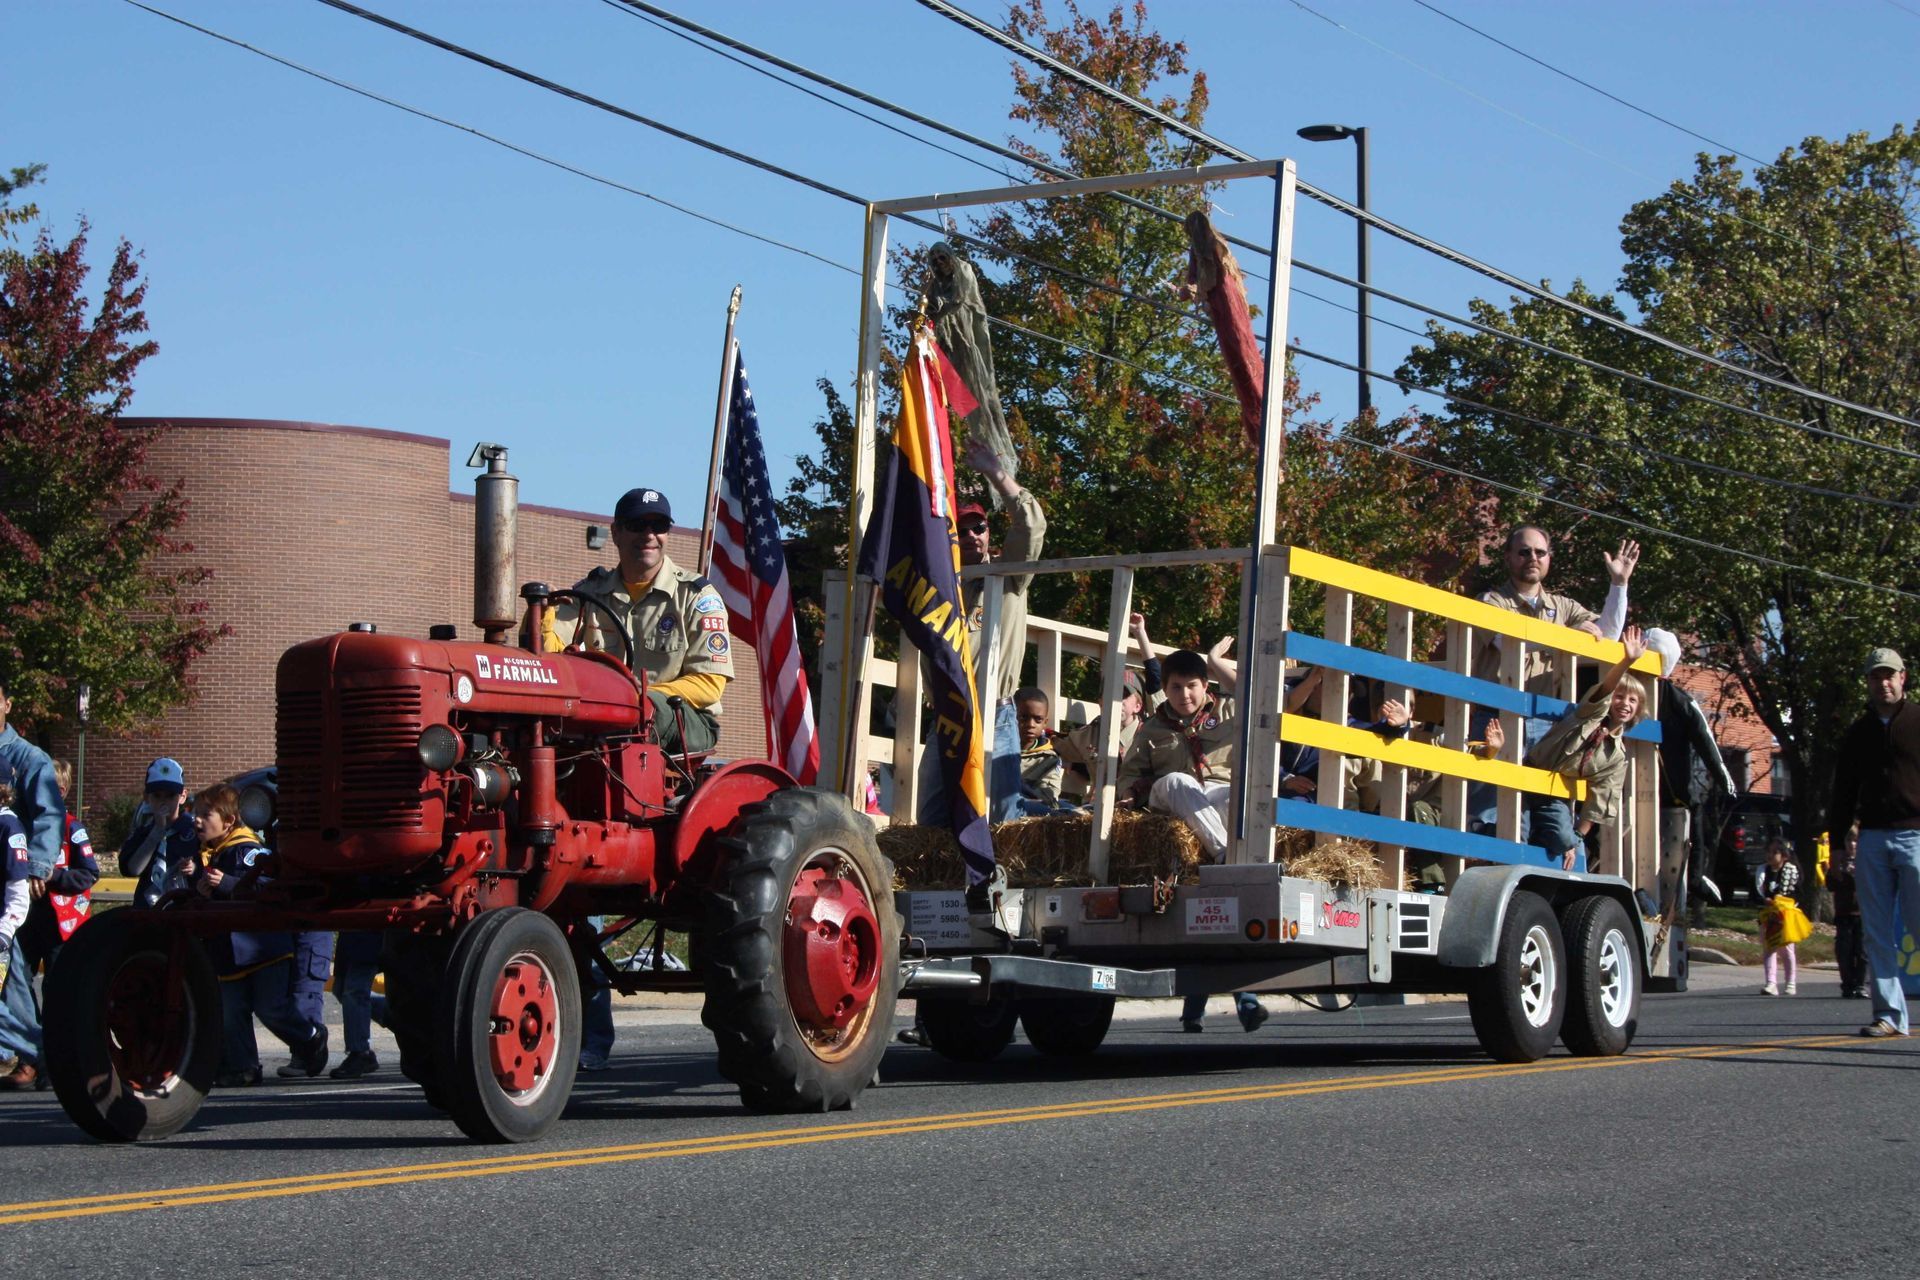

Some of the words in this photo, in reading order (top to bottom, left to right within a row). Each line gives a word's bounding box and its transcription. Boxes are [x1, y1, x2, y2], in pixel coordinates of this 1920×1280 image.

[703, 618, 723, 630] 863
[493, 664, 558, 684] FARMALL
[940, 900, 960, 908] 1530
[1202, 905, 1221, 914] 45
[940, 914, 960, 923] 5980
[1195, 915, 1229, 924] MPH
[940, 930, 960, 938] 4450
[1097, 971, 1103, 982] 7
